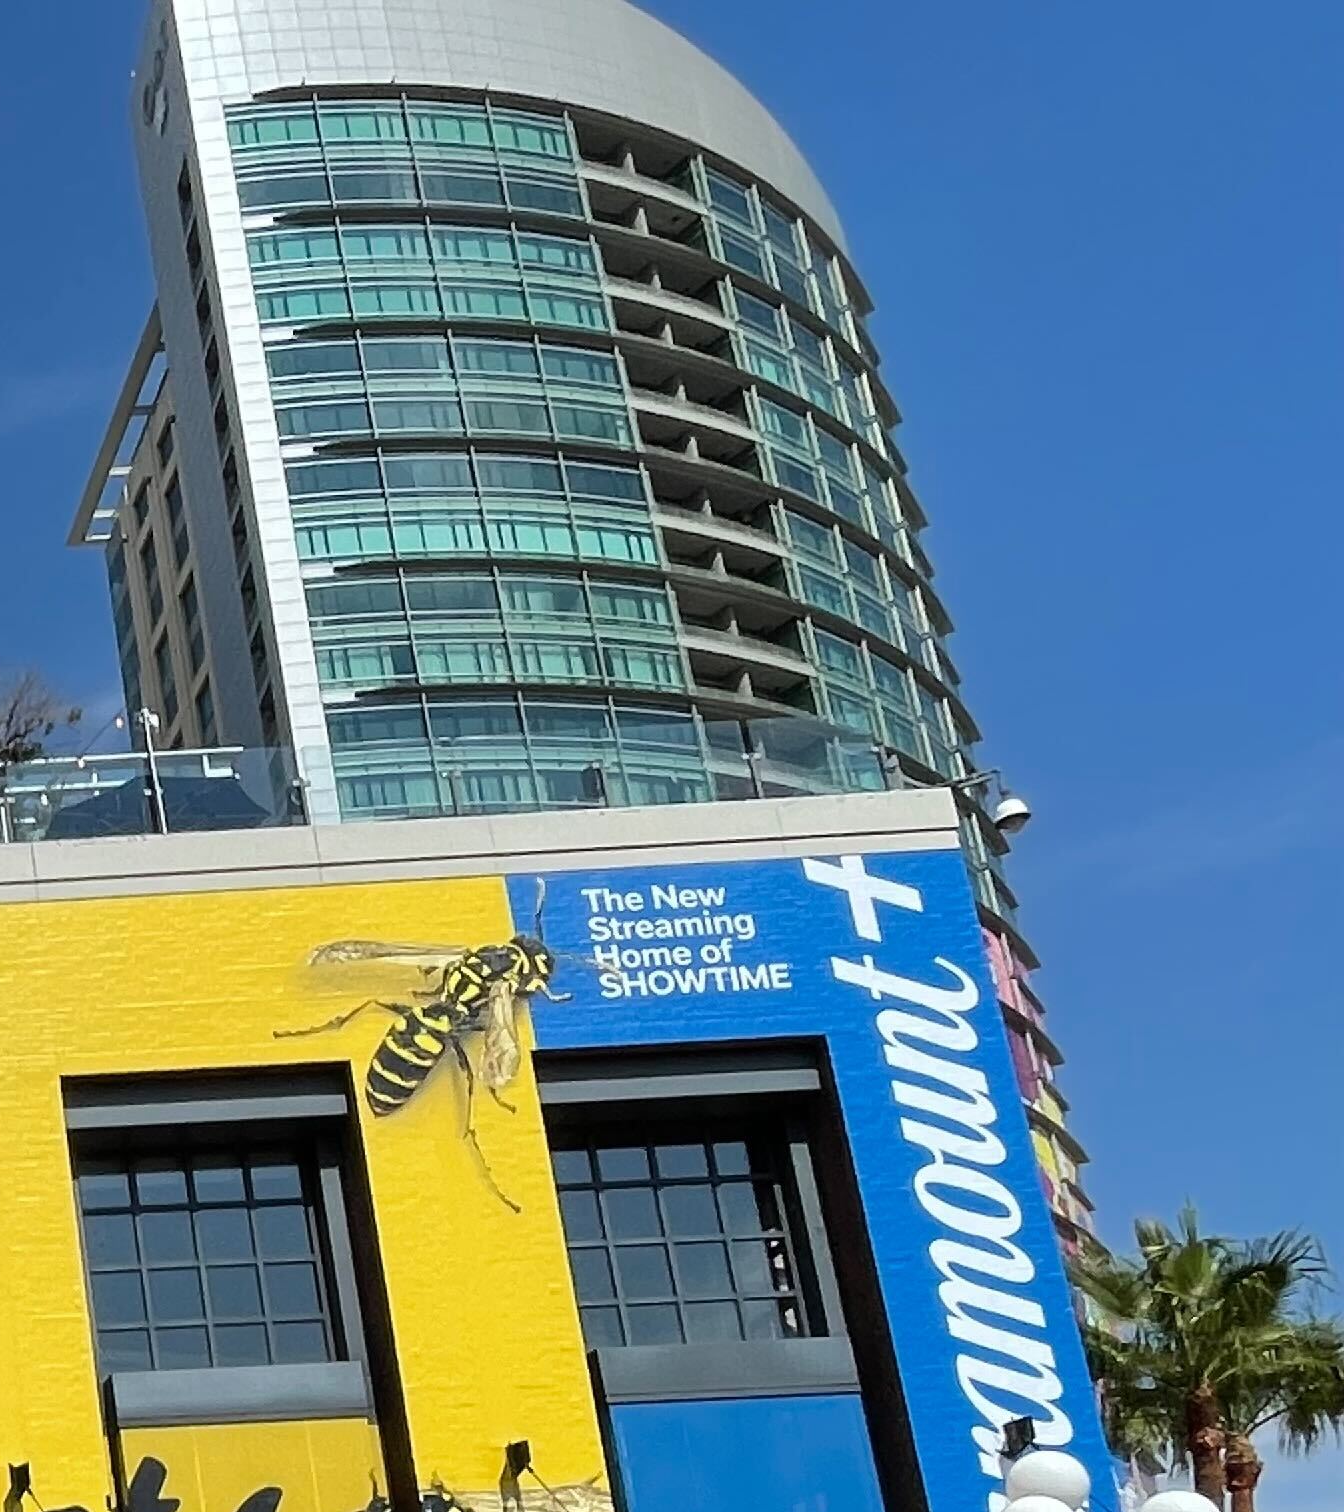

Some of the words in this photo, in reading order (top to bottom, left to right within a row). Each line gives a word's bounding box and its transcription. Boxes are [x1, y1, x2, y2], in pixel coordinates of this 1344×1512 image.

[580, 886, 645, 915] The
[651, 884, 725, 910] New
[588, 911, 756, 943] Streaming
[593, 941, 692, 969] Home
[699, 936, 733, 965] of
[598, 963, 792, 1000] SHOWTIME
